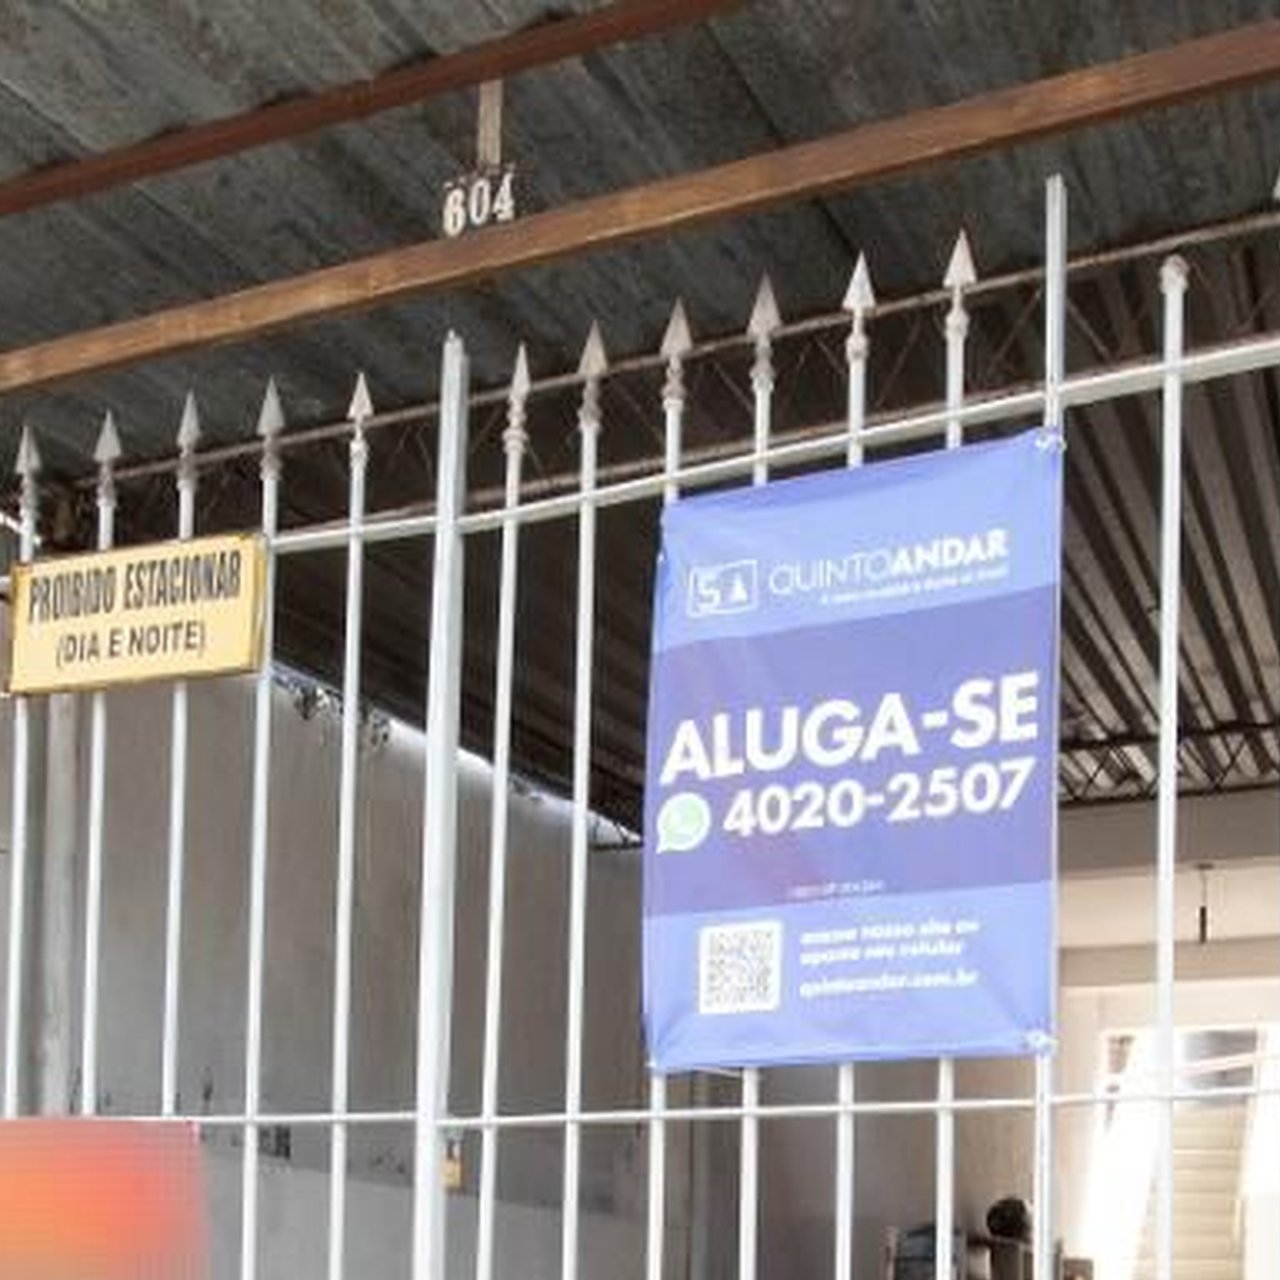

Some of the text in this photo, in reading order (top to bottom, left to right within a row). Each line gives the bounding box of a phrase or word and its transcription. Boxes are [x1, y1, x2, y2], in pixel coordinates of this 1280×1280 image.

[27, 550, 242, 623] PROIBIDO ESTACIONAR
[768, 530, 1008, 595] QUINTOANDAR
[56, 620, 206, 668] (DIA E NOITE)
[659, 671, 1040, 785] ALUGA-SE
[723, 757, 1037, 838] 4020-2507
